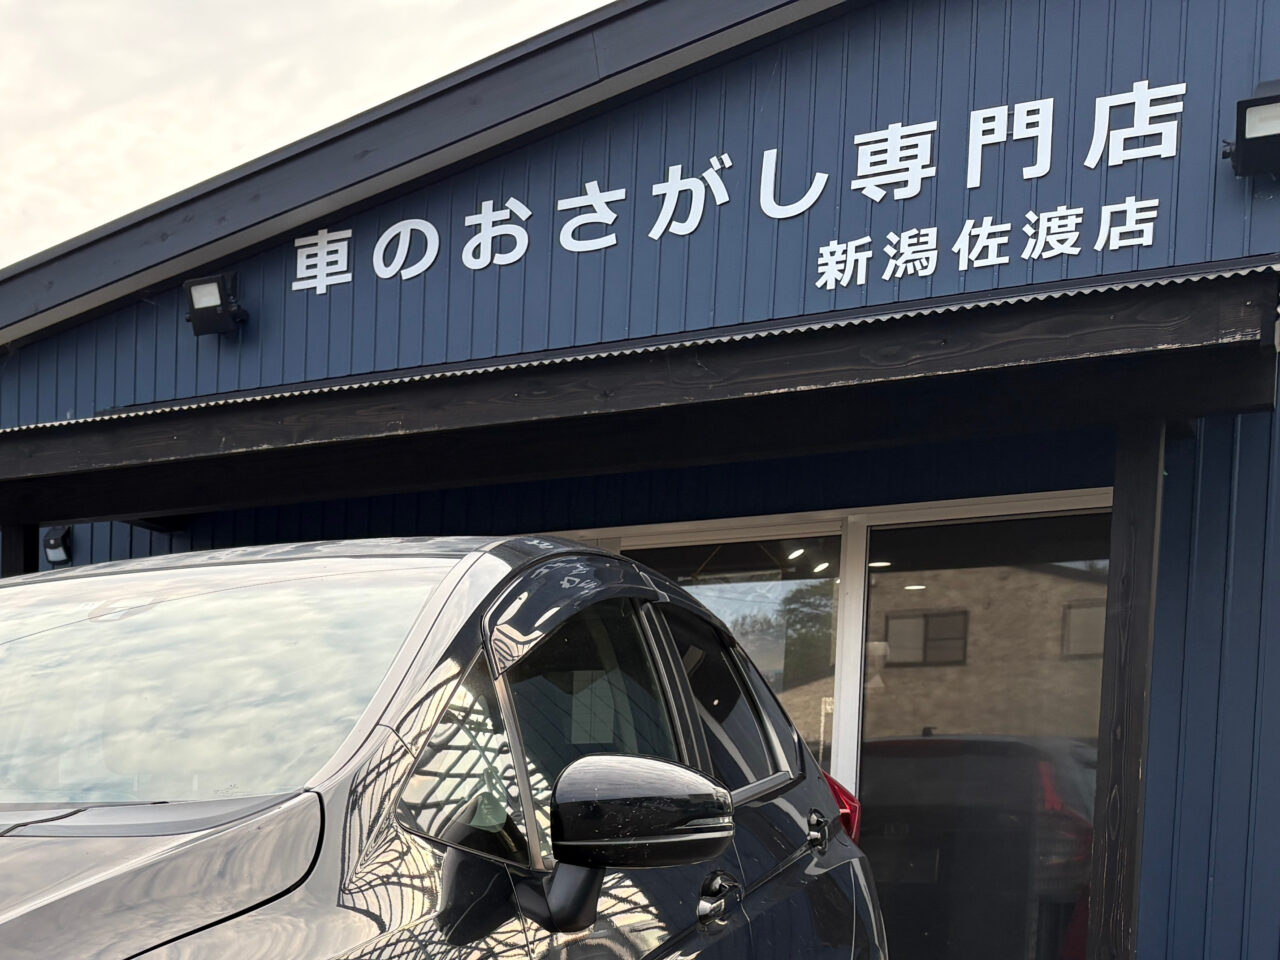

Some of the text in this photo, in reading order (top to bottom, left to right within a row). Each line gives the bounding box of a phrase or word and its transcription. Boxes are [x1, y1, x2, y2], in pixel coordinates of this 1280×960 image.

[291, 79, 1188, 295] 車のおさがし専門店
[815, 195, 1160, 290] 新潟佐渡店
